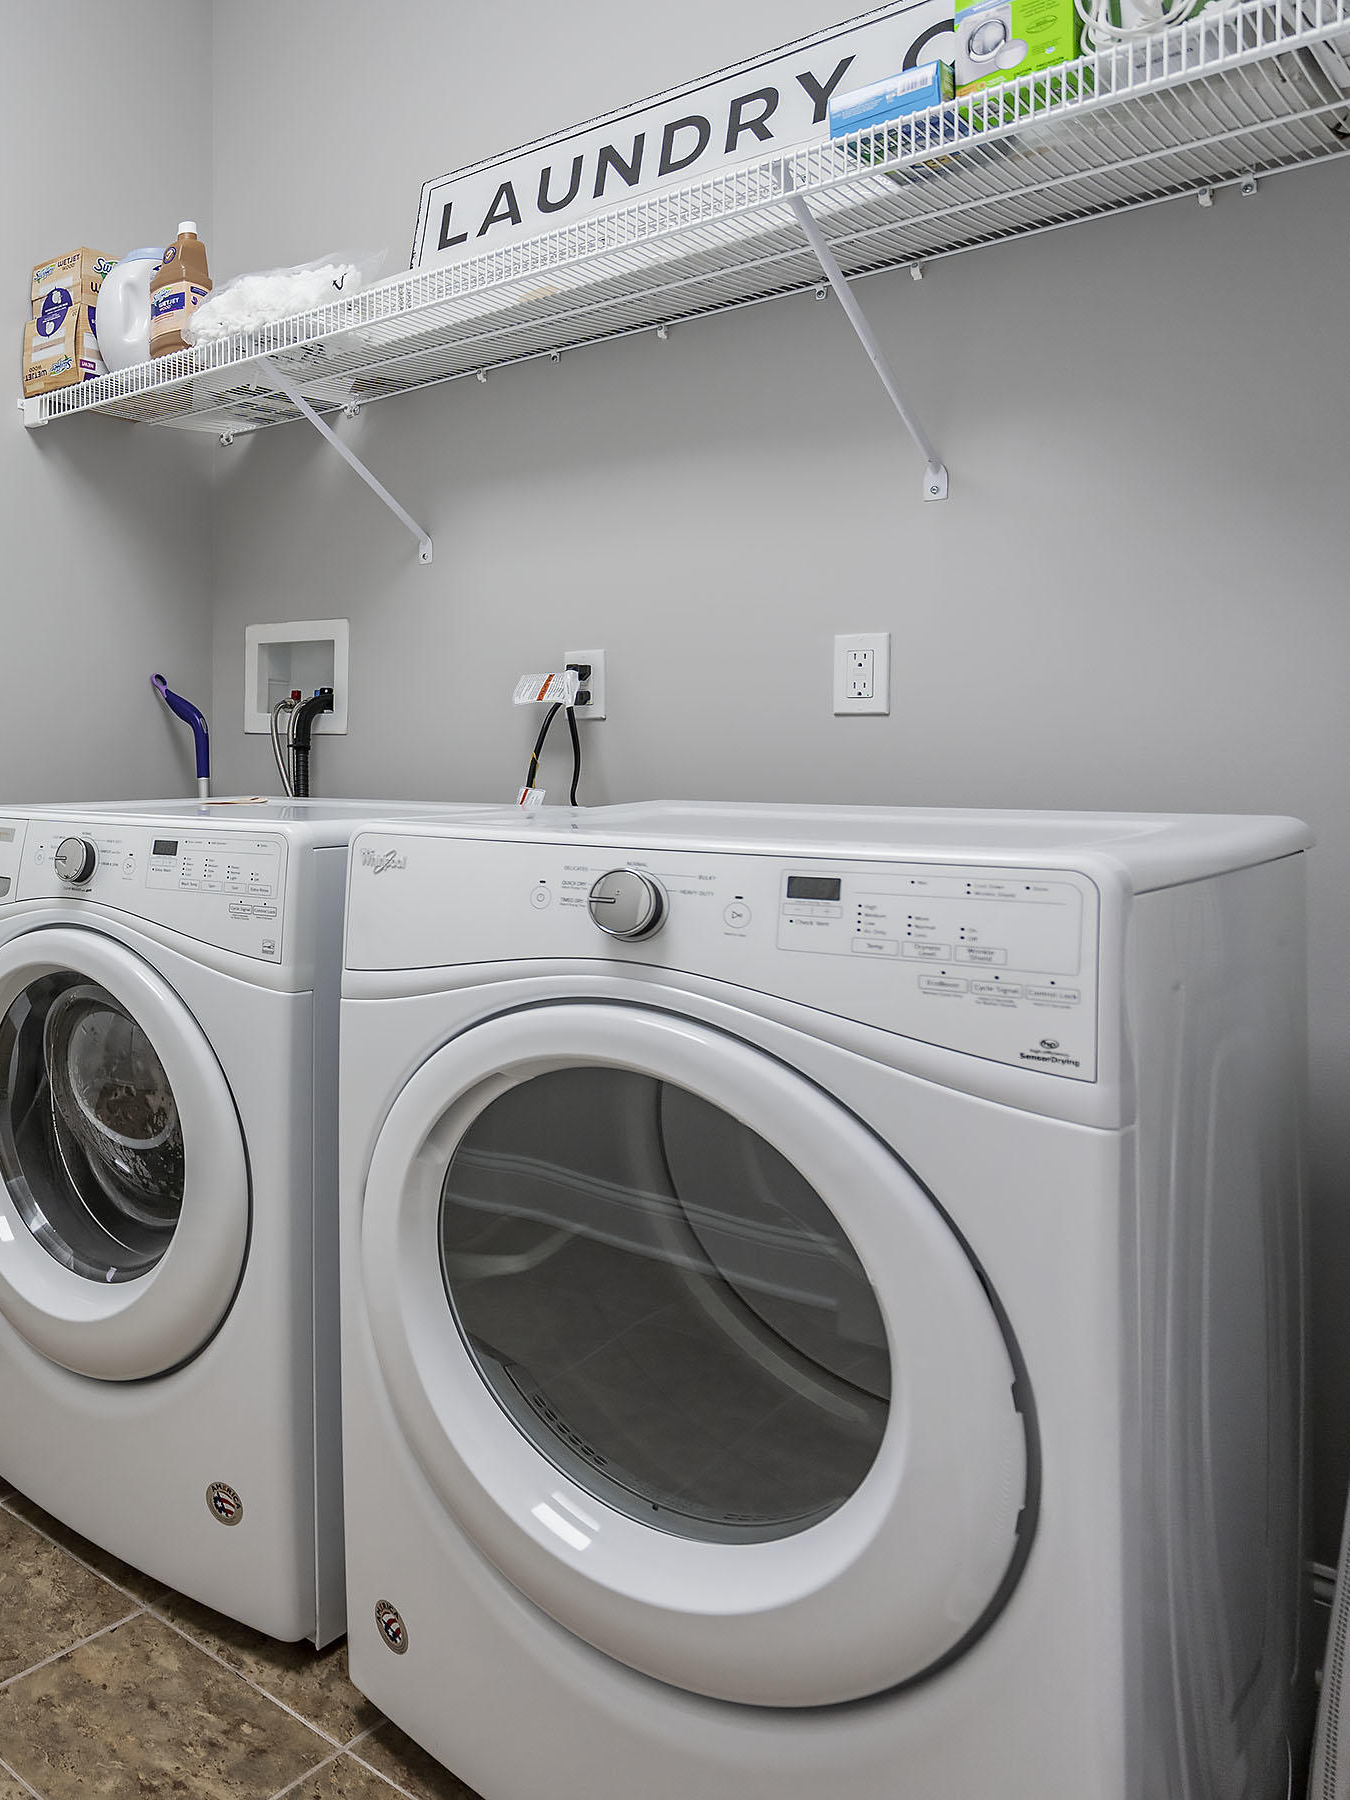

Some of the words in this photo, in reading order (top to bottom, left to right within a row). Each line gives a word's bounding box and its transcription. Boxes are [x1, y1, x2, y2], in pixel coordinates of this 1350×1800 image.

[437, 54, 857, 251] LAUNDRY
[57, 253, 80, 268] WETJET
[1019, 1052, 1081, 1067] SensorDrying
[211, 1483, 241, 1509] AMERICA
